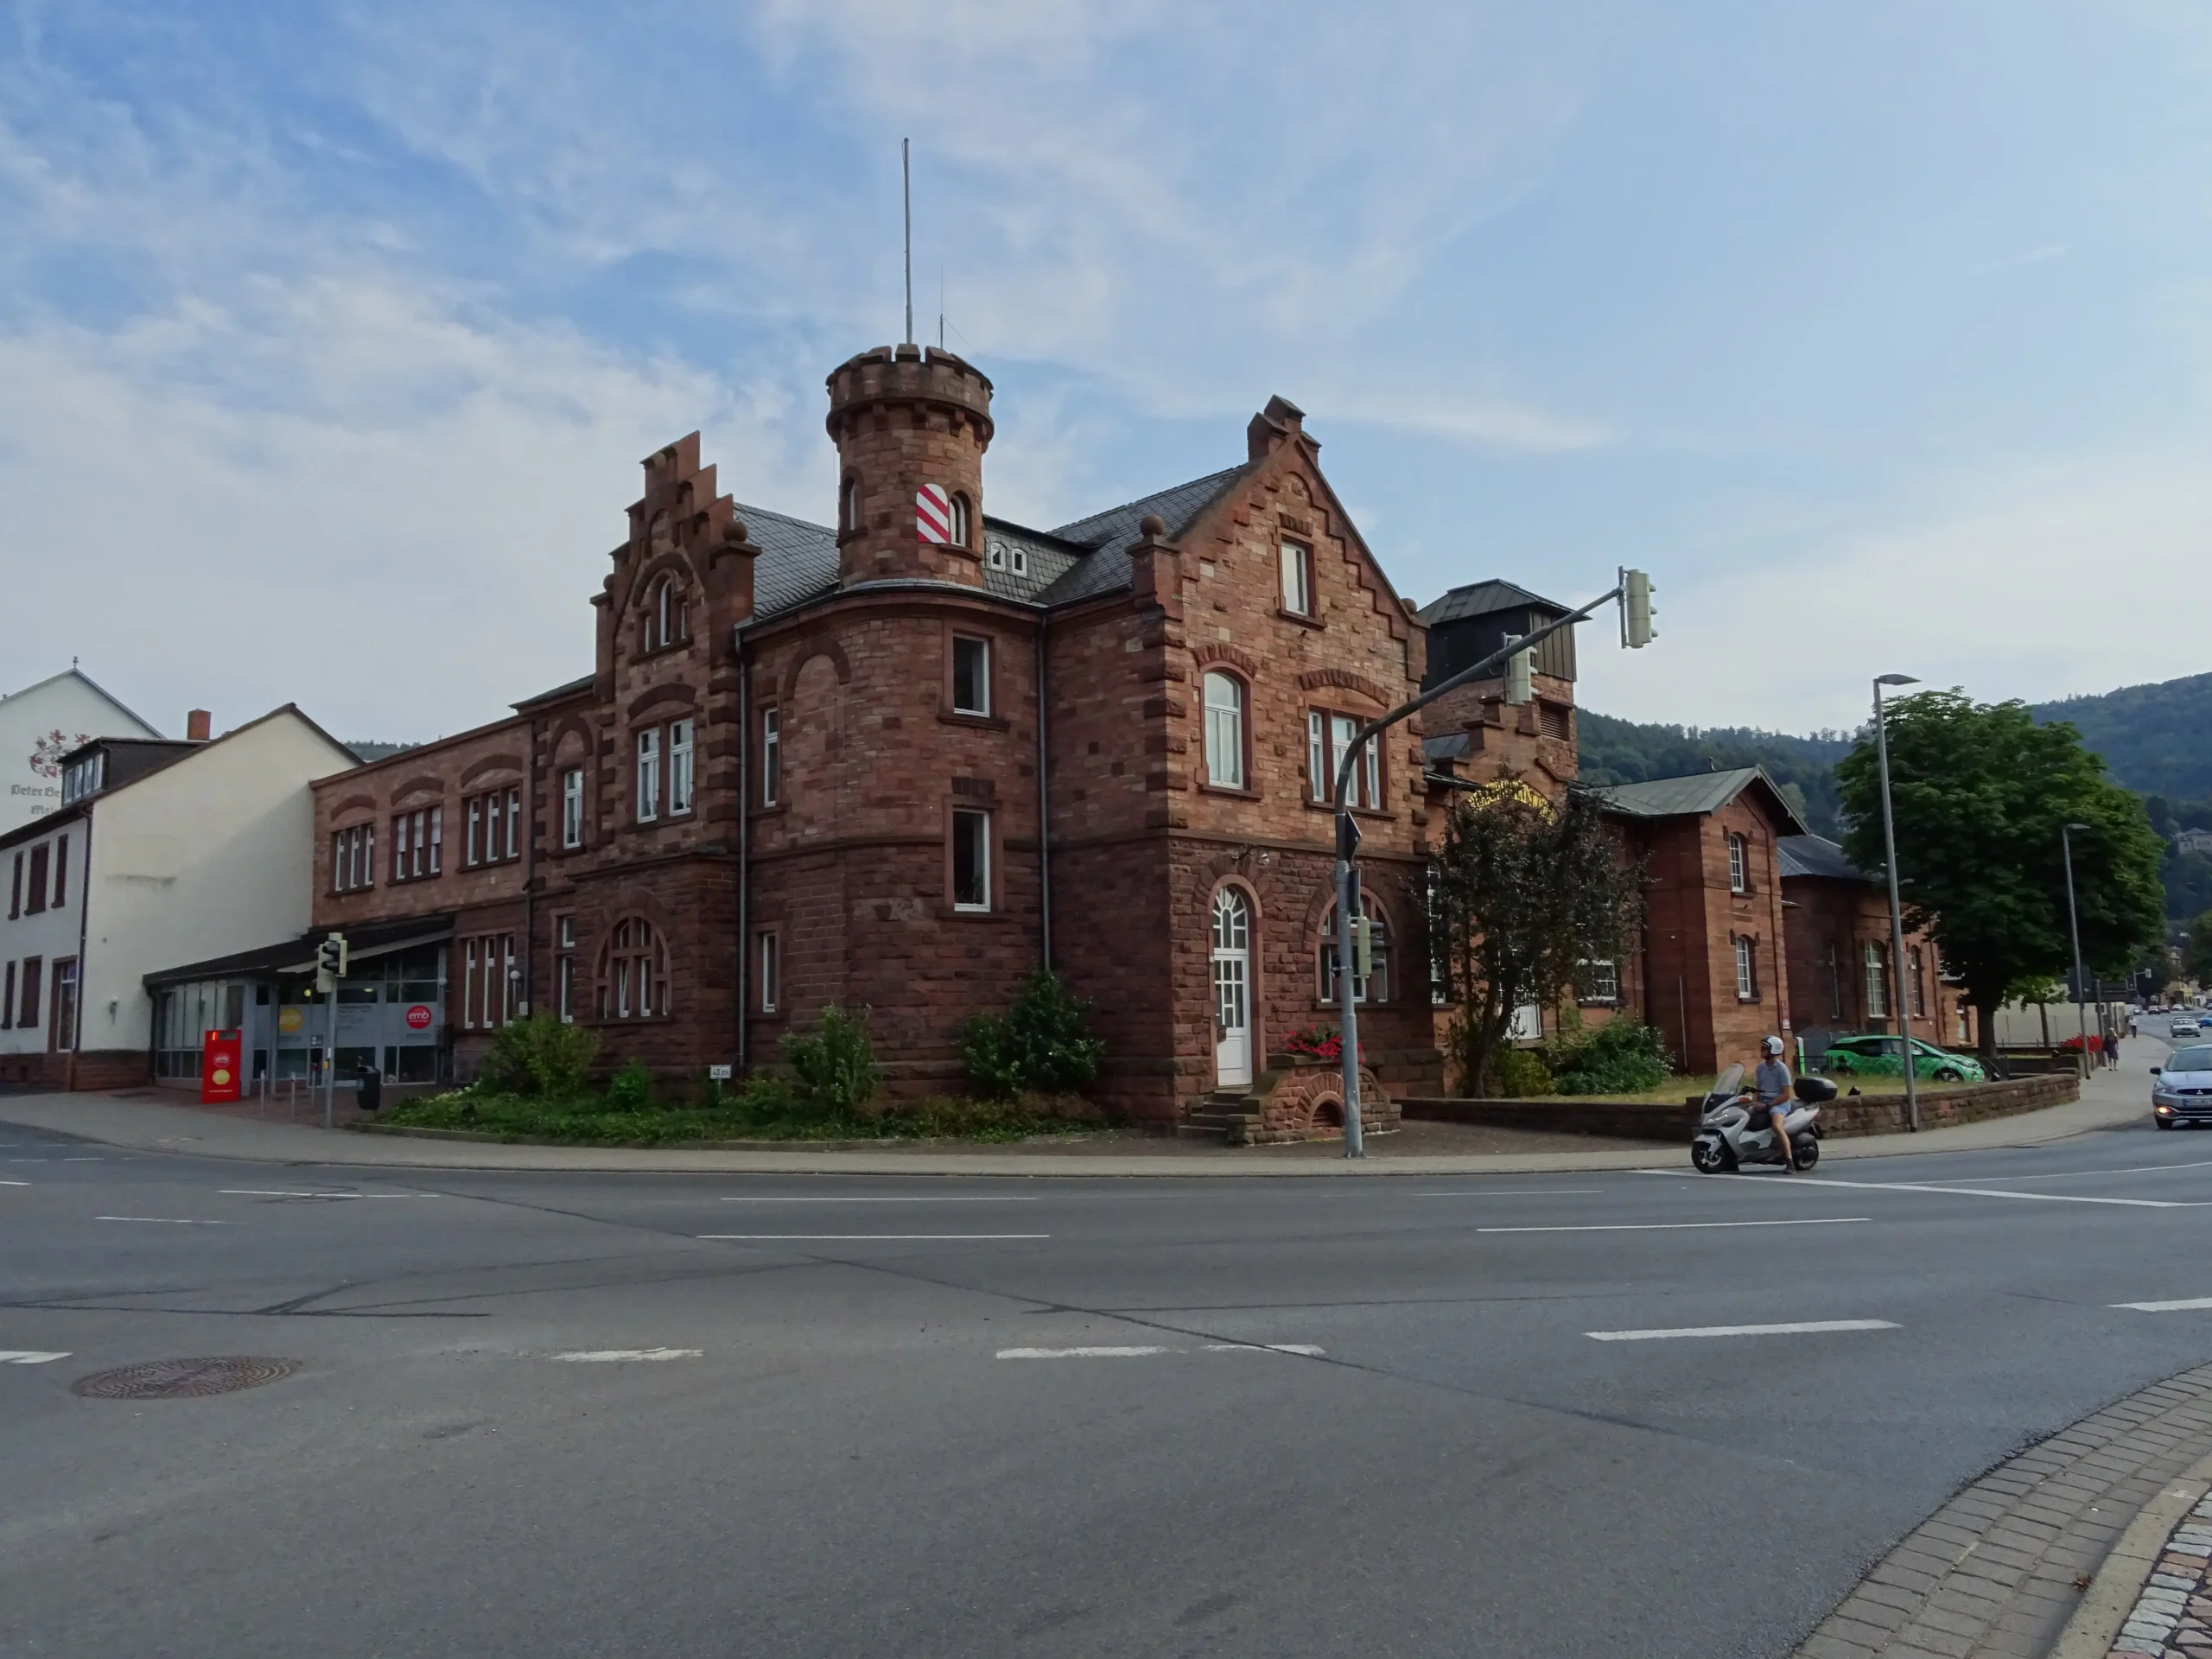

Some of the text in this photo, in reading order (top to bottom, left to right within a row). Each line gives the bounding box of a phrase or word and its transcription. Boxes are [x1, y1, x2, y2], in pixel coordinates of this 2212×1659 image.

[10, 785, 62, 798] Peter Be
[409, 1011, 429, 1020] emb
